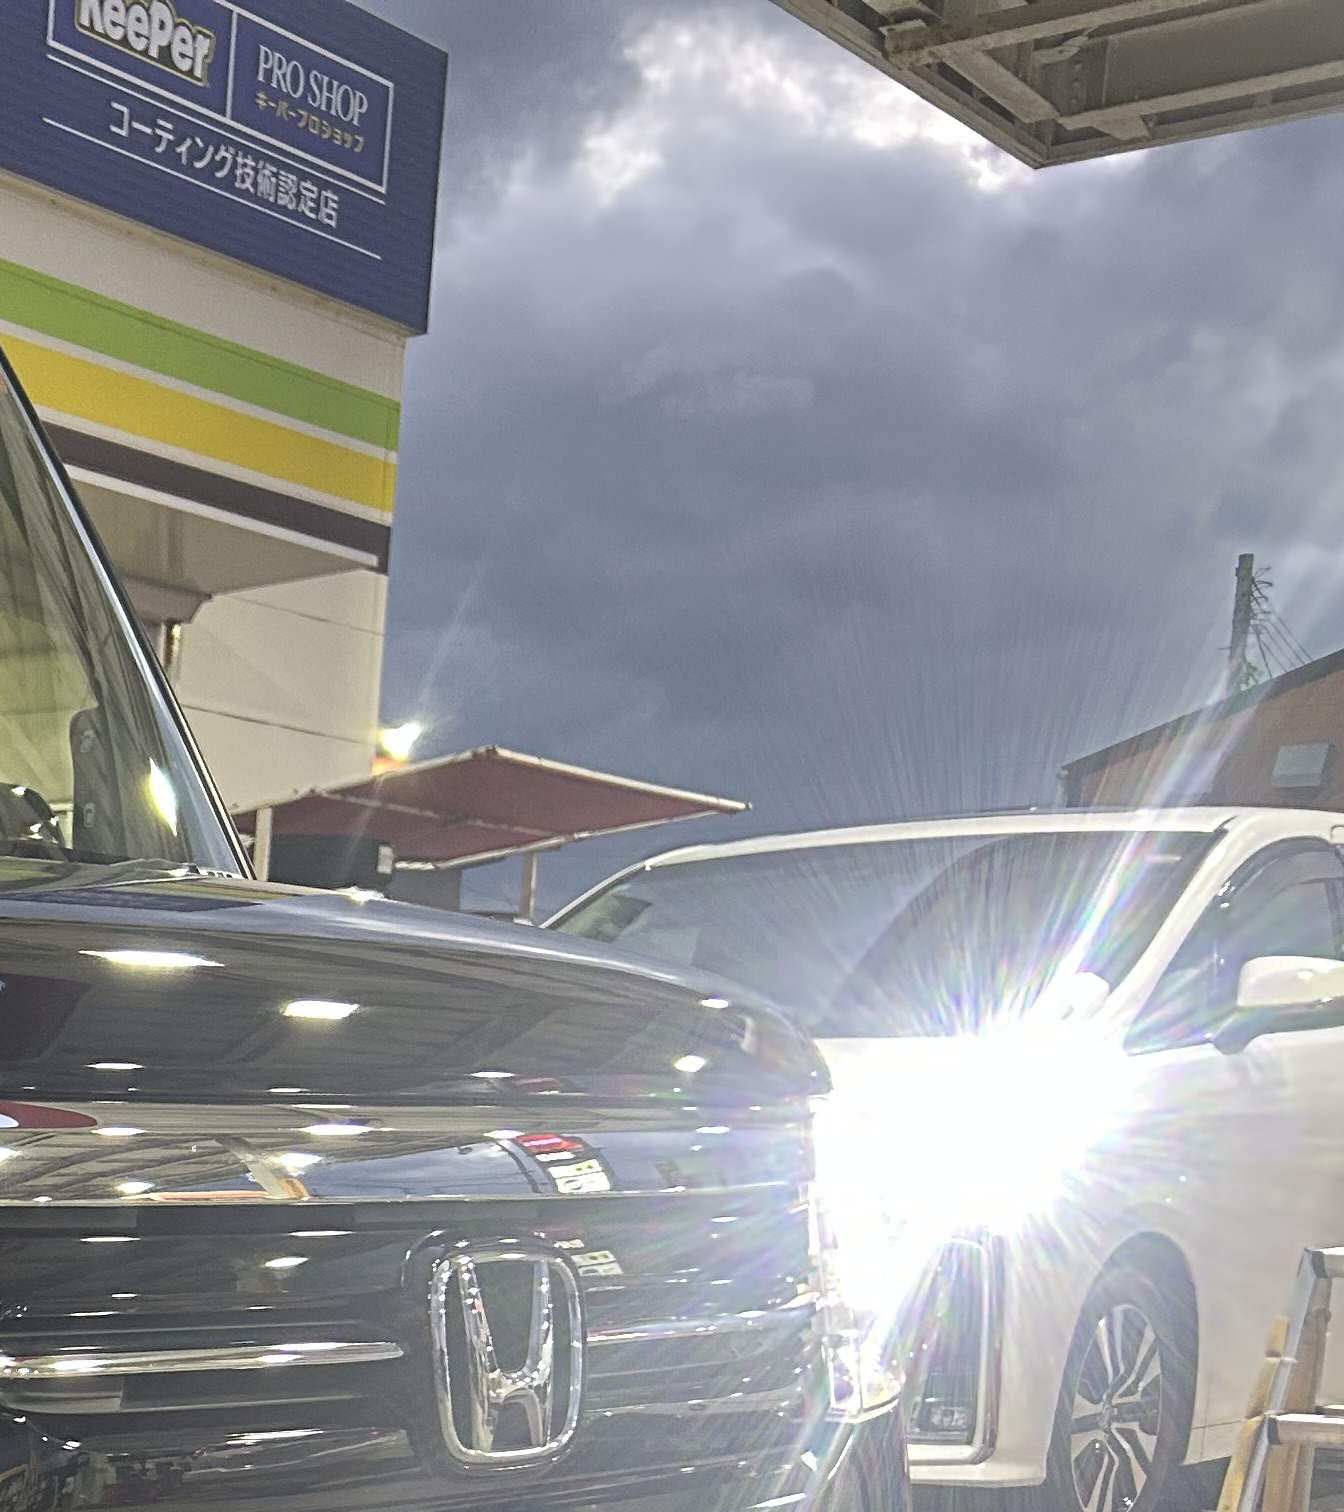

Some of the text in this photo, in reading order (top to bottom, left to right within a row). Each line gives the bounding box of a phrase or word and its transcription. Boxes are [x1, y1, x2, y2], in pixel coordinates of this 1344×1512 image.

[256, 44, 369, 127] PRO SHOP
[108, 100, 340, 229] コーティング技術認定店
